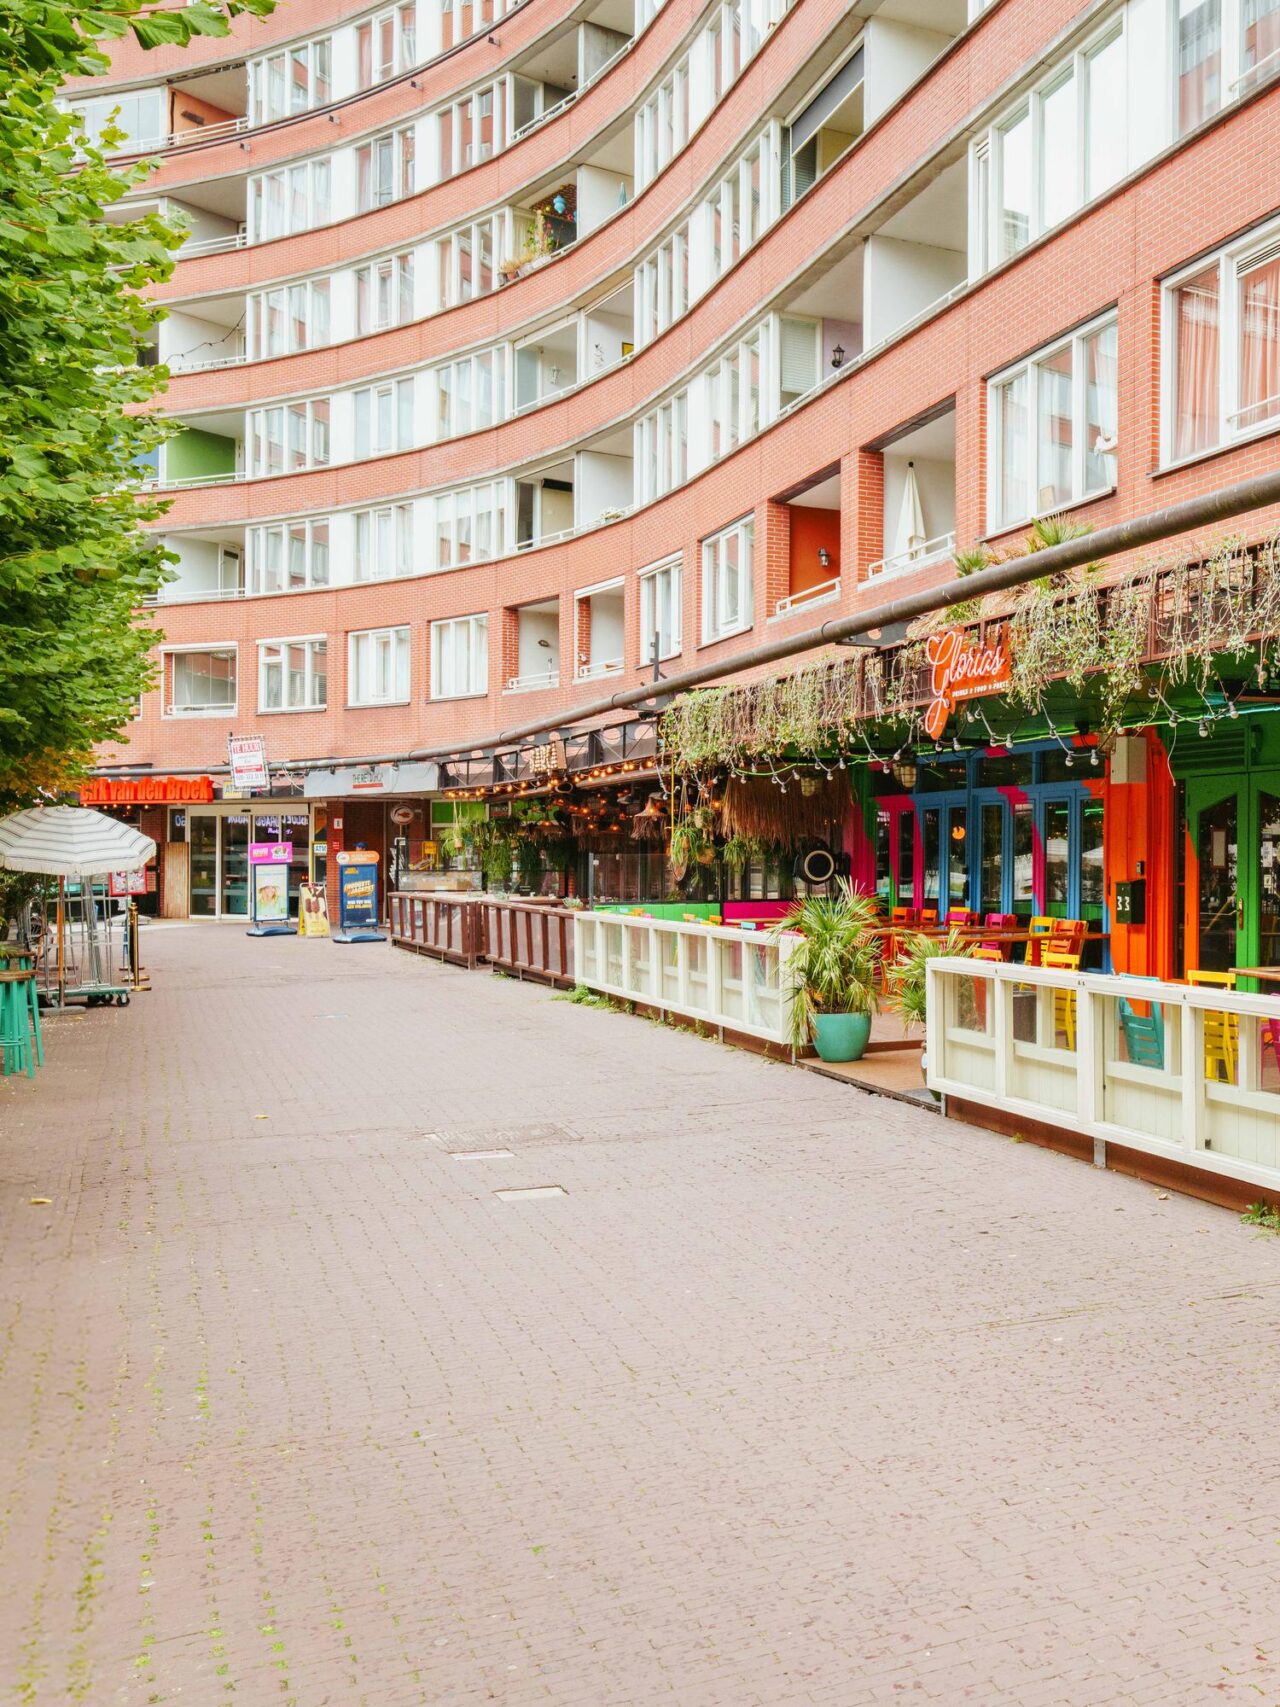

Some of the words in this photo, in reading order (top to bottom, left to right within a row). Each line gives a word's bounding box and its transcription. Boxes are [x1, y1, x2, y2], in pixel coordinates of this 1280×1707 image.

[110, 781, 135, 801] van
[138, 777, 163, 801] den
[166, 776, 209, 801] Broek
[1116, 895, 1130, 911] 33
